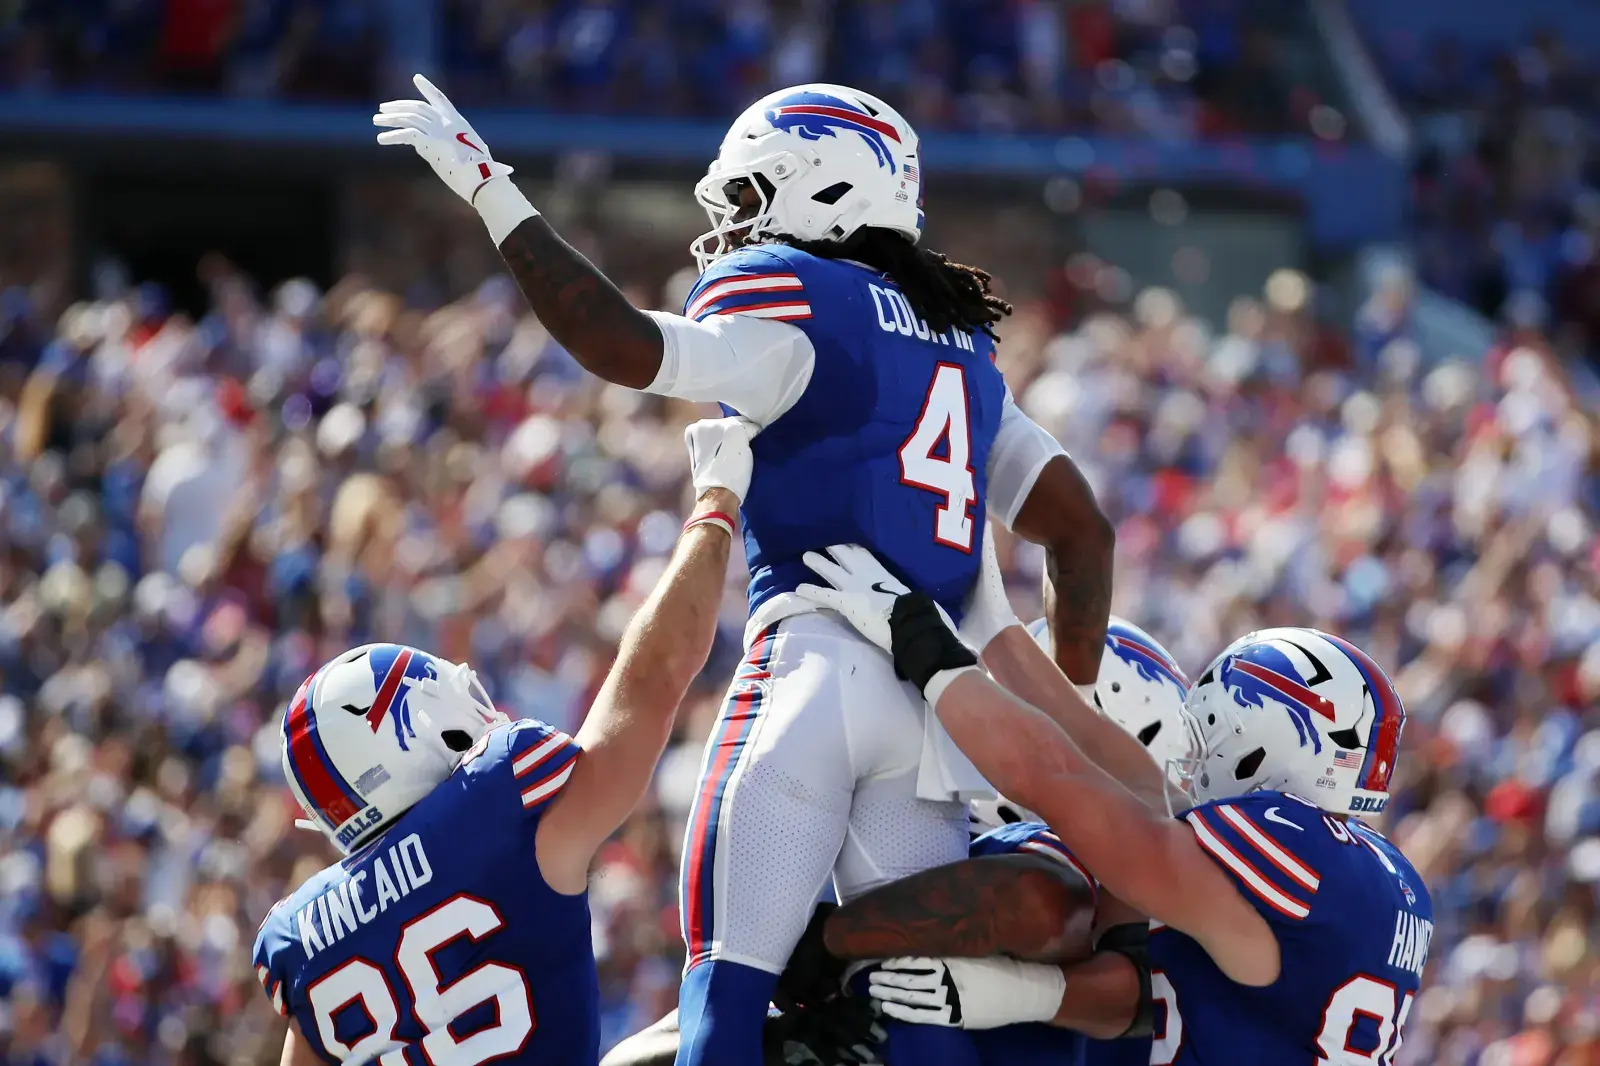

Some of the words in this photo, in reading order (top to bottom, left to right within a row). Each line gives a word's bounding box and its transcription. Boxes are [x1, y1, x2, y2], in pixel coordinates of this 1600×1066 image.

[897, 360, 979, 555] 4
[297, 832, 433, 961] KINCAID
[335, 805, 383, 847] BILLS
[305, 891, 538, 1066] 86
